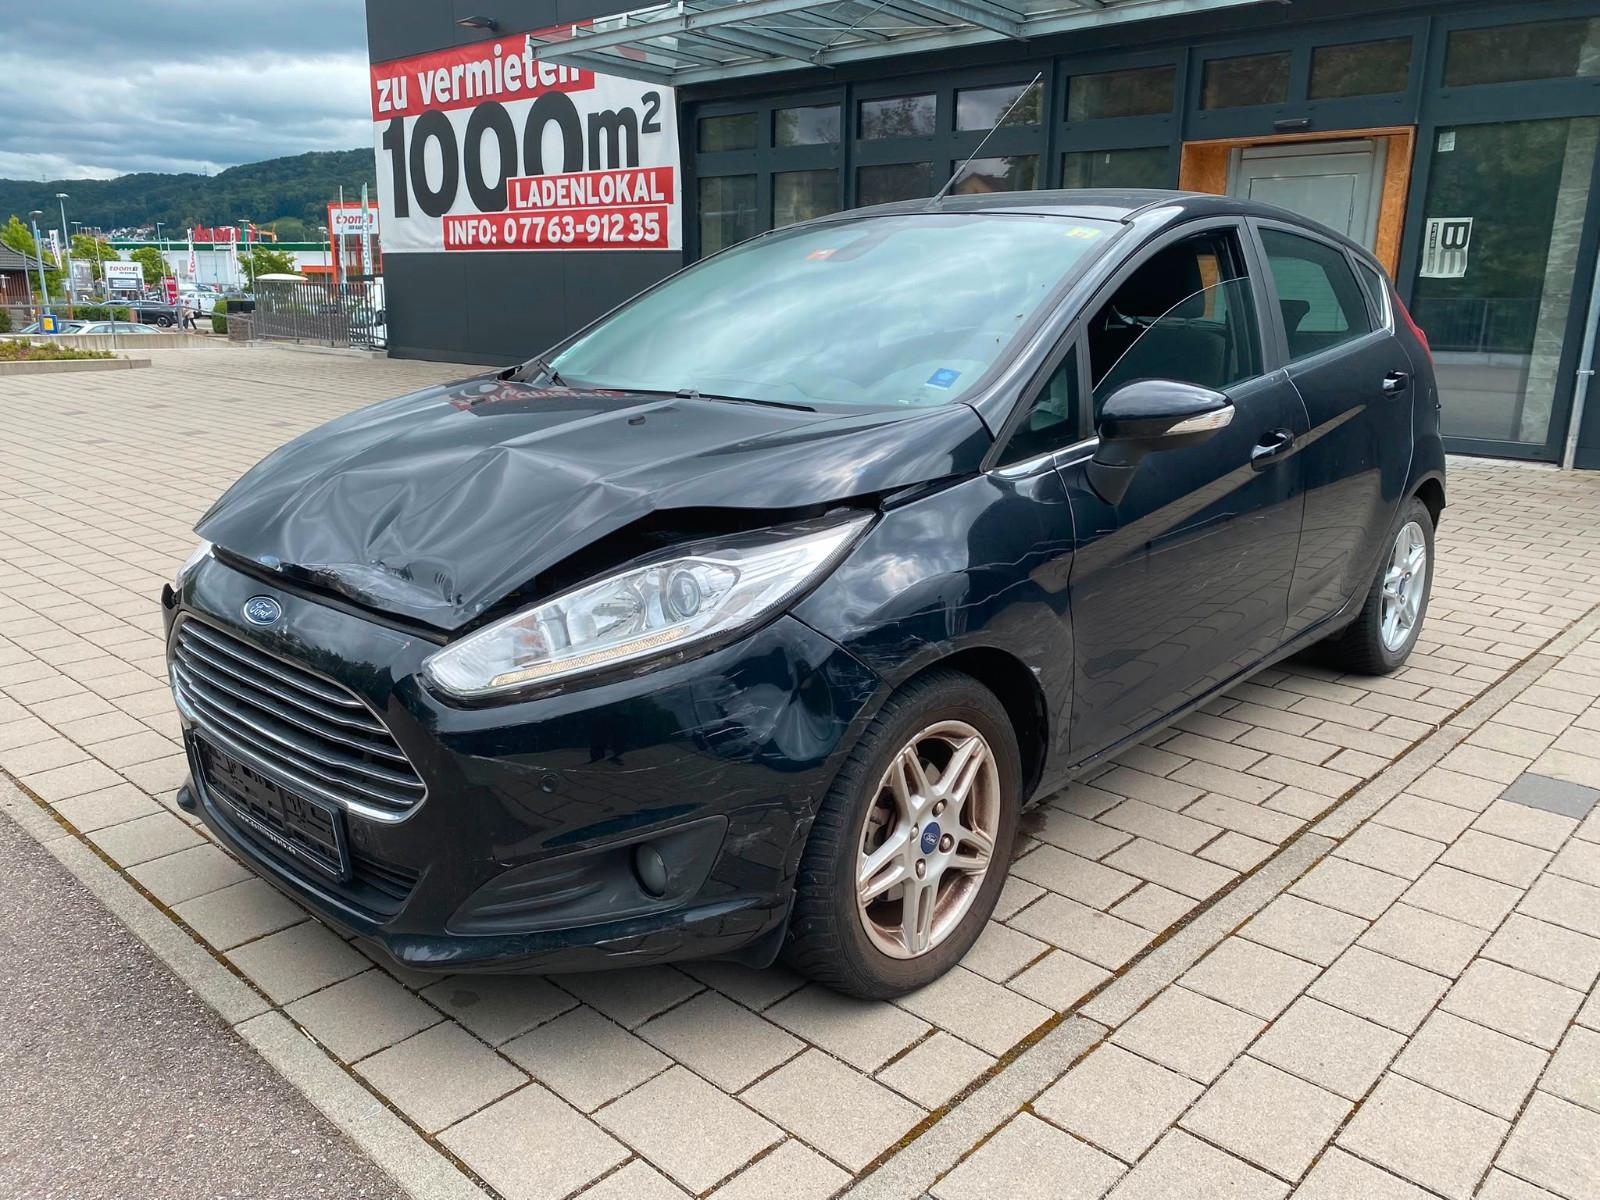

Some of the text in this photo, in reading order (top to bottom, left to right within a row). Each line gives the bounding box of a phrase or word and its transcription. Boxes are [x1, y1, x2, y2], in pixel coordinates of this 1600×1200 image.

[377, 75, 408, 112] zu
[515, 172, 665, 208] LADENLOKAL
[448, 219, 497, 245] INFO:
